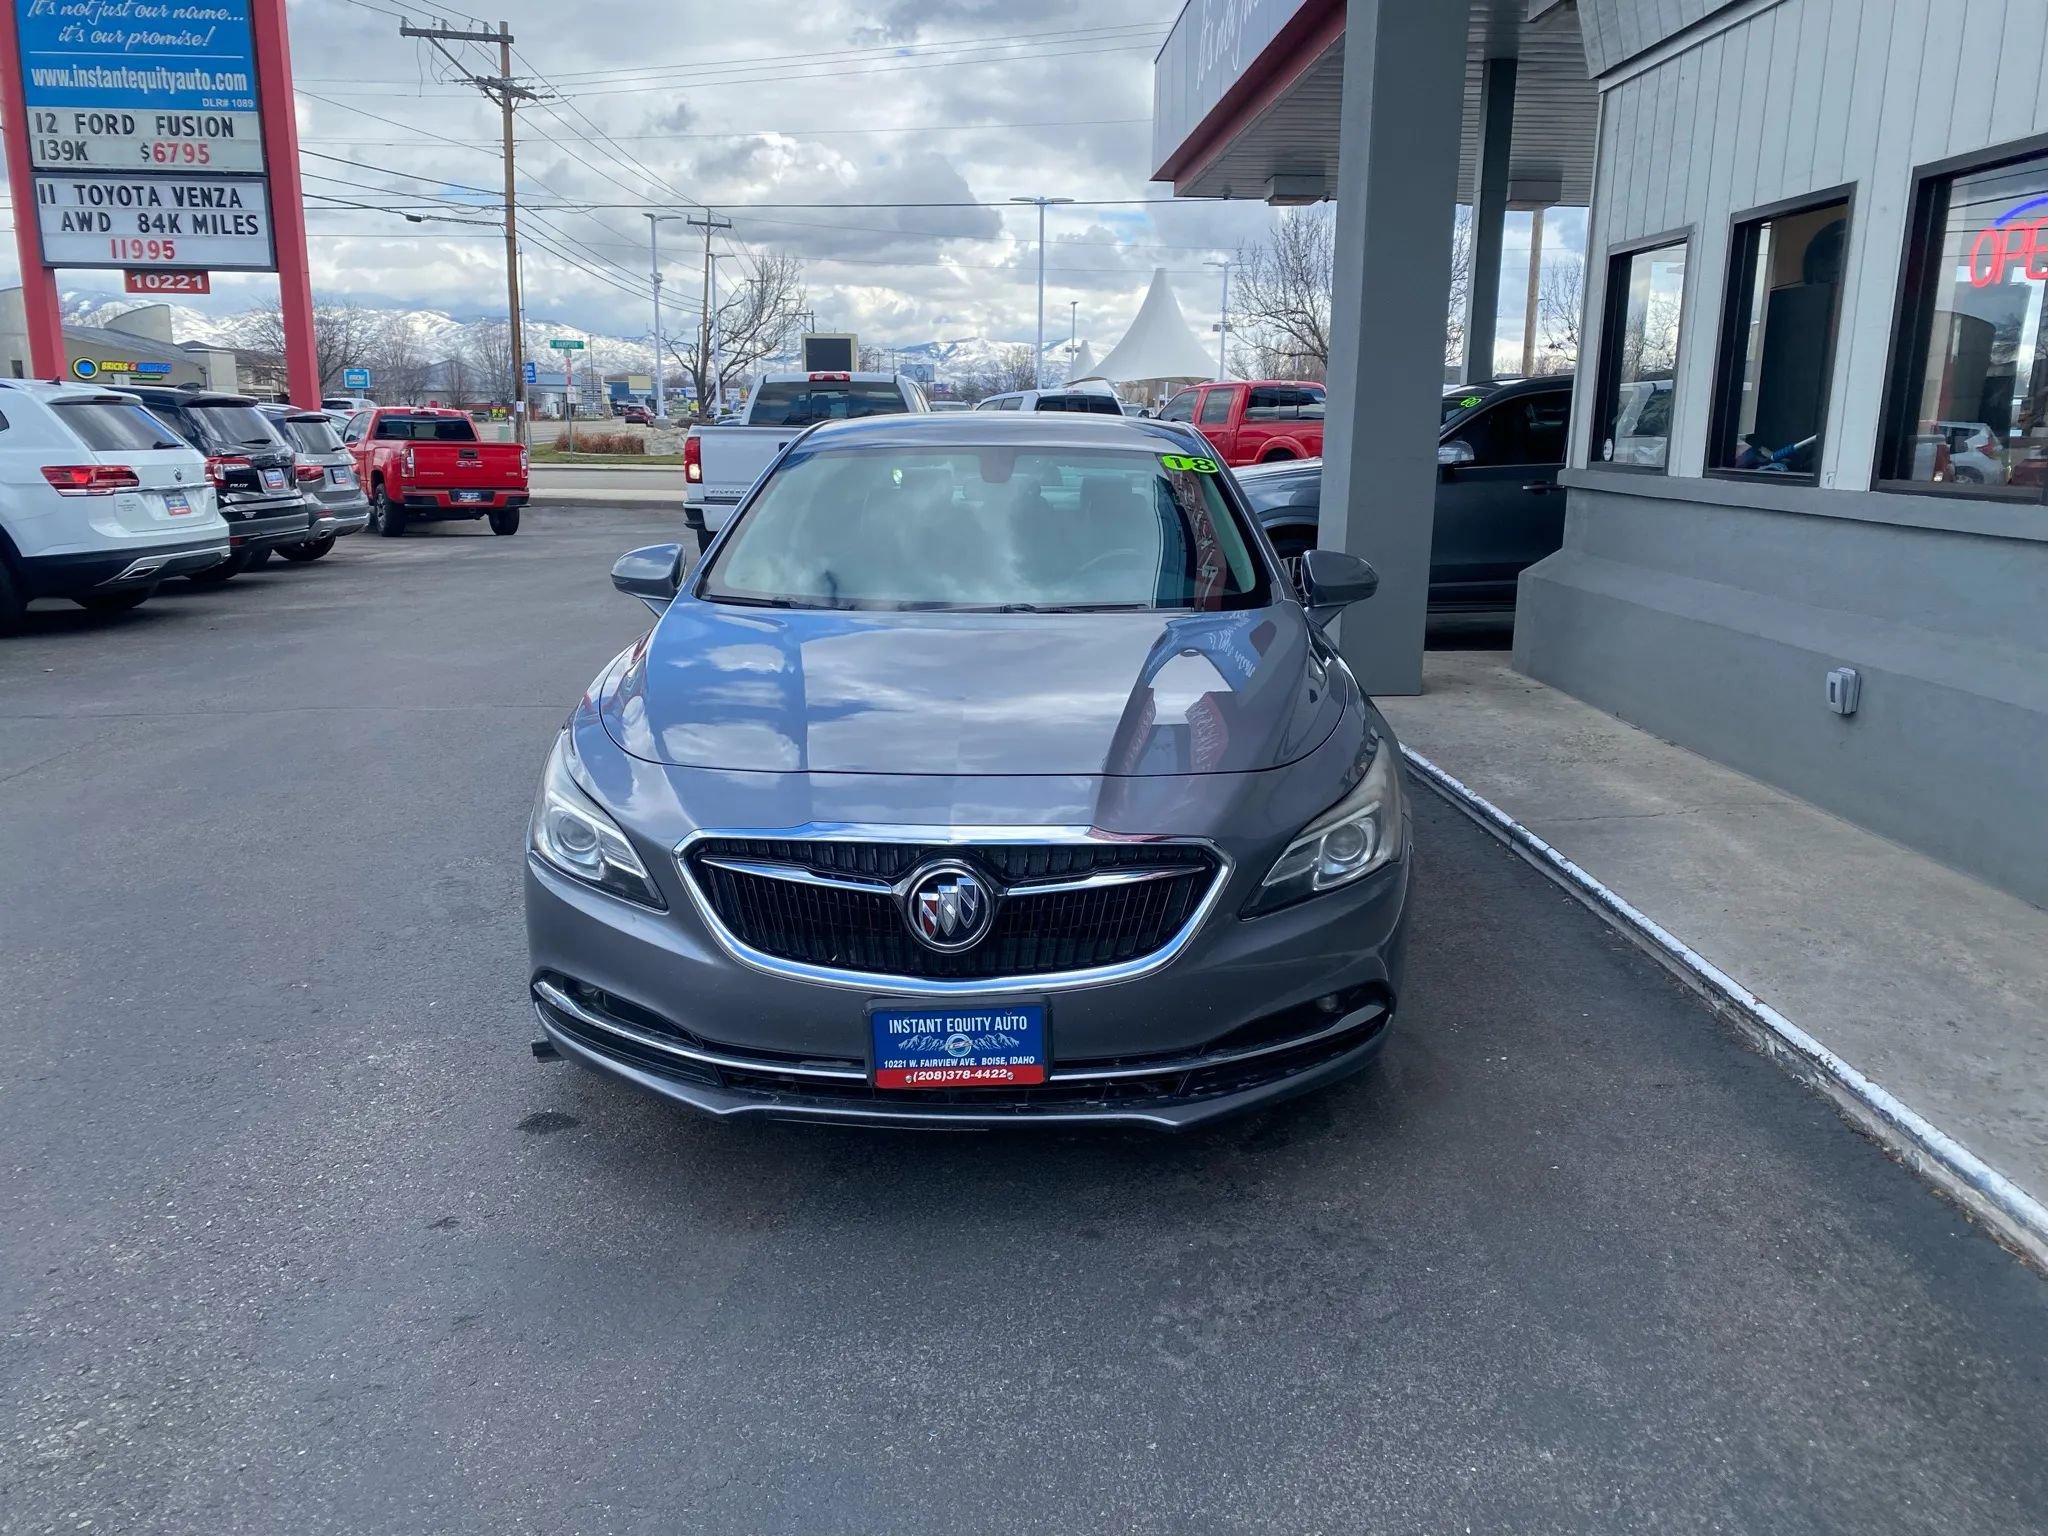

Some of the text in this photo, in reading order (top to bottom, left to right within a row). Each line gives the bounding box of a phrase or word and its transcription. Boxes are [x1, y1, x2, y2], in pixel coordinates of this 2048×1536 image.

[27, 0, 56, 17] It's
[60, 0, 97, 16] not
[88, 1, 138, 26] just
[135, 4, 169, 18] our
[58, 22, 216, 51] it's our promise!
[31, 64, 248, 95] www.instantequityauto.com
[202, 98, 254, 108] DLR# 1089
[35, 112, 235, 138] 12 FORD FUSION
[40, 140, 210, 166] 139K $6795
[38, 184, 243, 209] 11 TOYOTA VENZA
[61, 212, 259, 236] AWD 84K MILES
[110, 239, 176, 260] 11995
[131, 274, 203, 290] 10221
[1167, 455, 1216, 472] 18
[889, 1015, 1028, 1034] INSTANT EQUITY AUTO
[884, 1055, 1035, 1068] 10221 W. FAIRVIEW AVE. BOISE, IDAHO
[912, 1068, 1008, 1083] (208)378-4422
